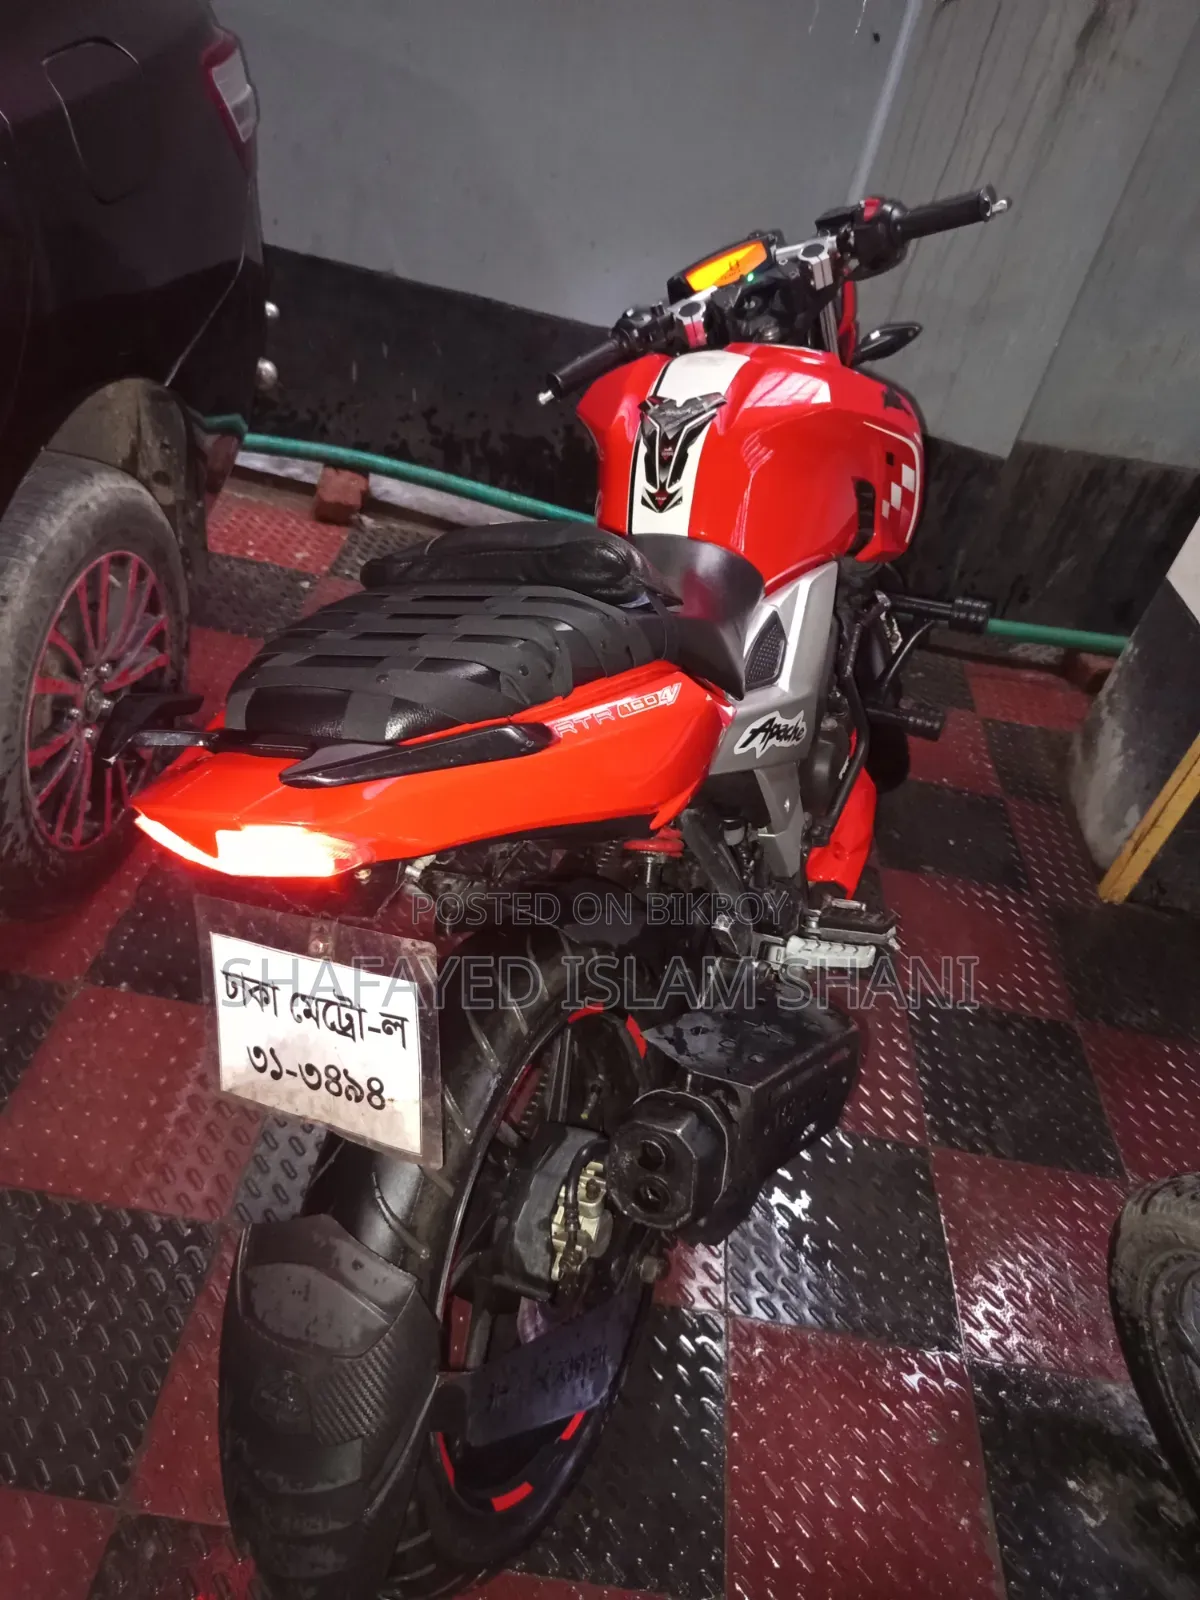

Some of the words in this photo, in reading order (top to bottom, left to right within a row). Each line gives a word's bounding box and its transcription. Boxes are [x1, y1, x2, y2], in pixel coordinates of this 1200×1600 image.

[553, 708, 615, 738] RTR
[739, 716, 805, 751] Apache
[221, 970, 280, 1017] ঢাকা
[290, 989, 409, 1049] মেট্রো-ল
[247, 1045, 386, 1110] ৩১-৩৪৯৪
